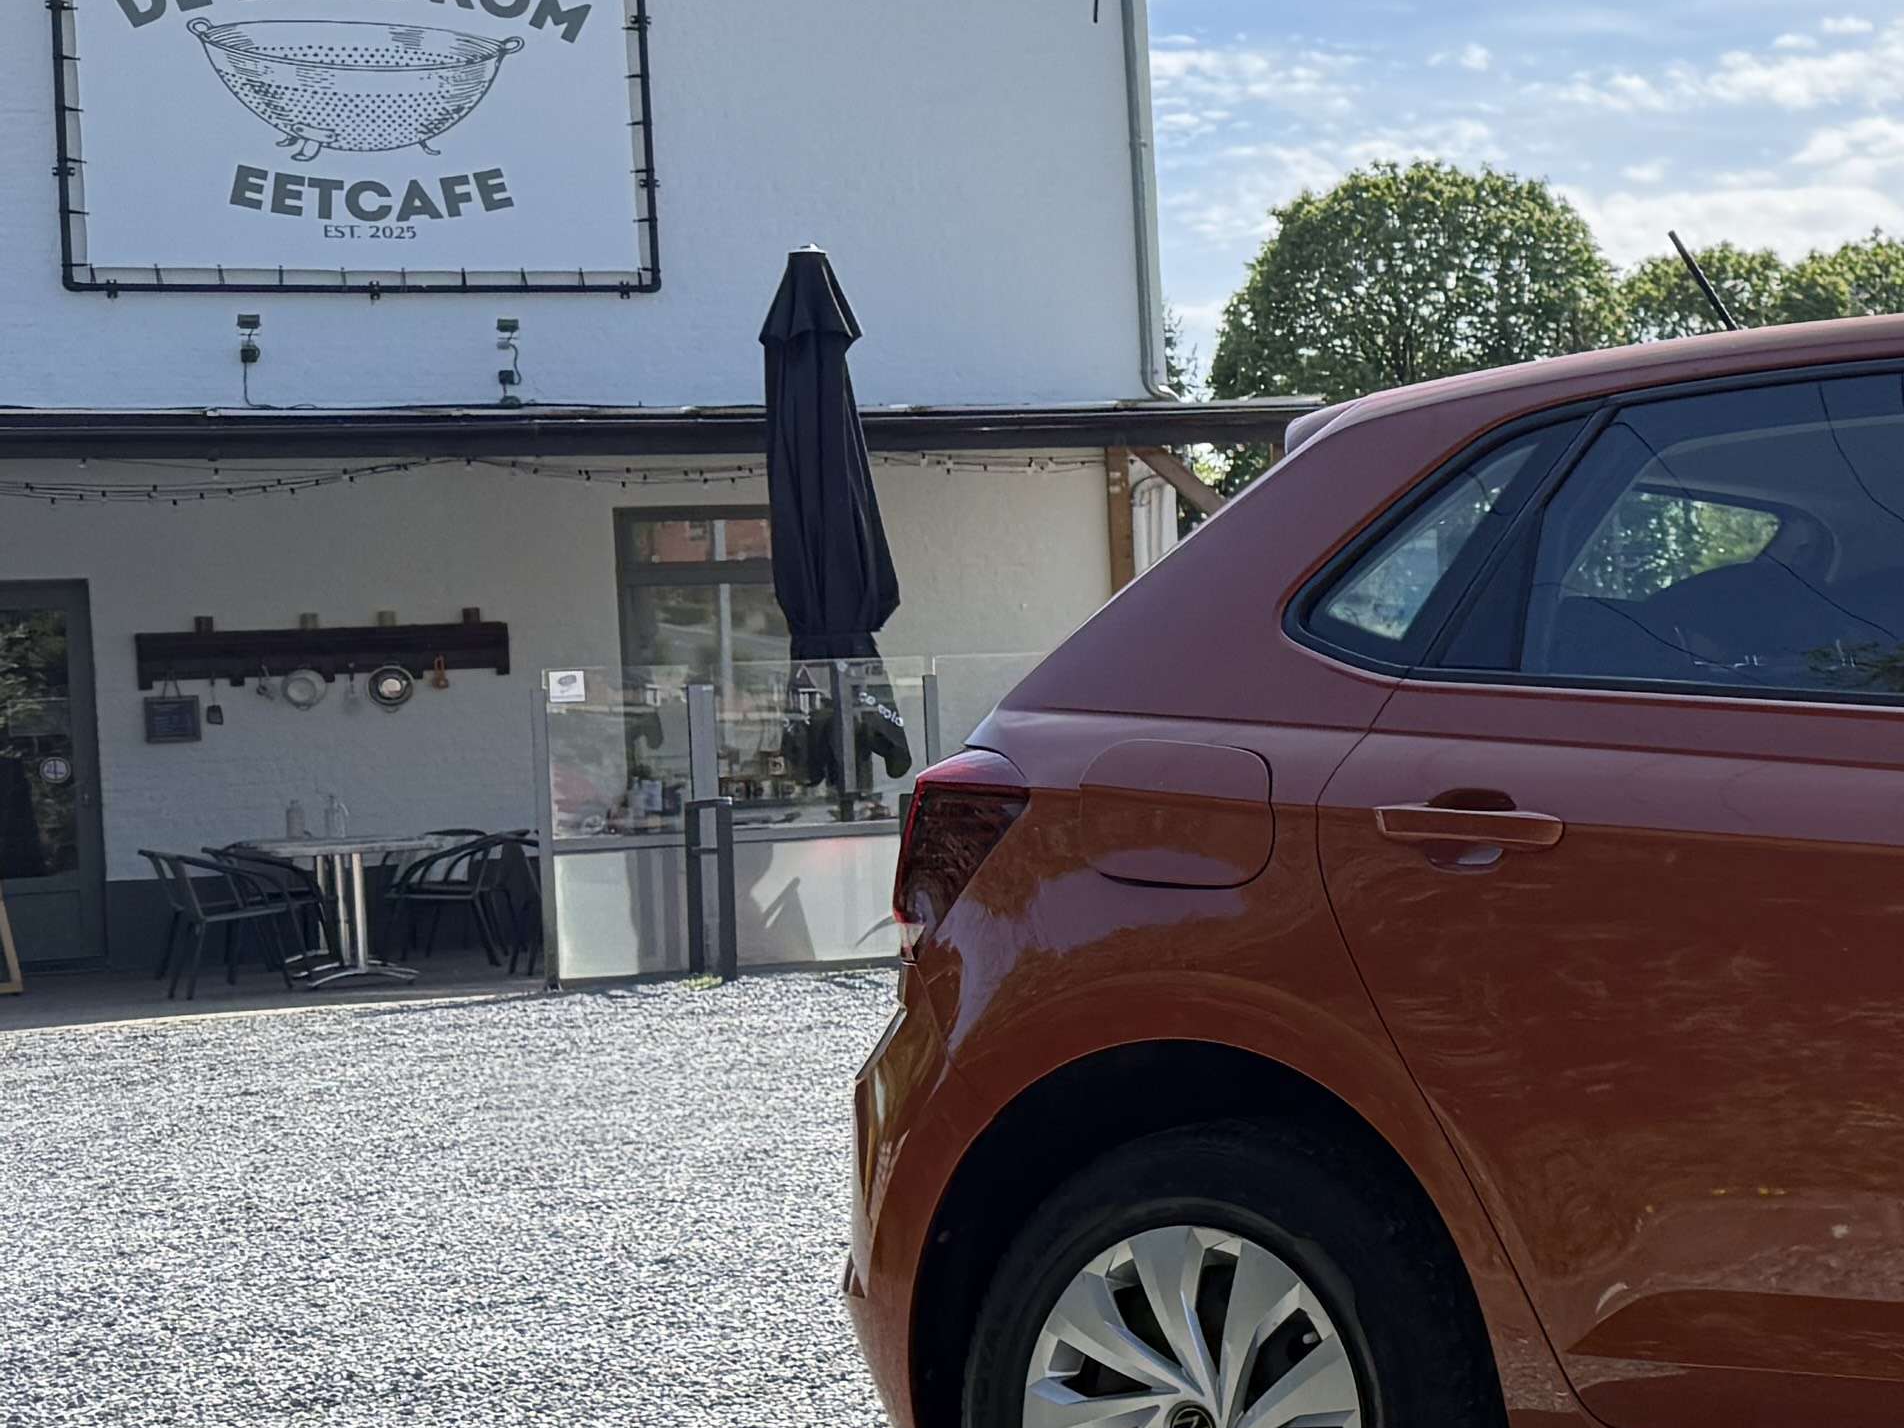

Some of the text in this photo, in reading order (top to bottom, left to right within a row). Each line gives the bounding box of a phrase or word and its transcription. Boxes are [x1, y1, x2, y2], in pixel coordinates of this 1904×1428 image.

[229, 164, 515, 222] EETCAFE
[323, 225, 417, 240] EST. 2025
